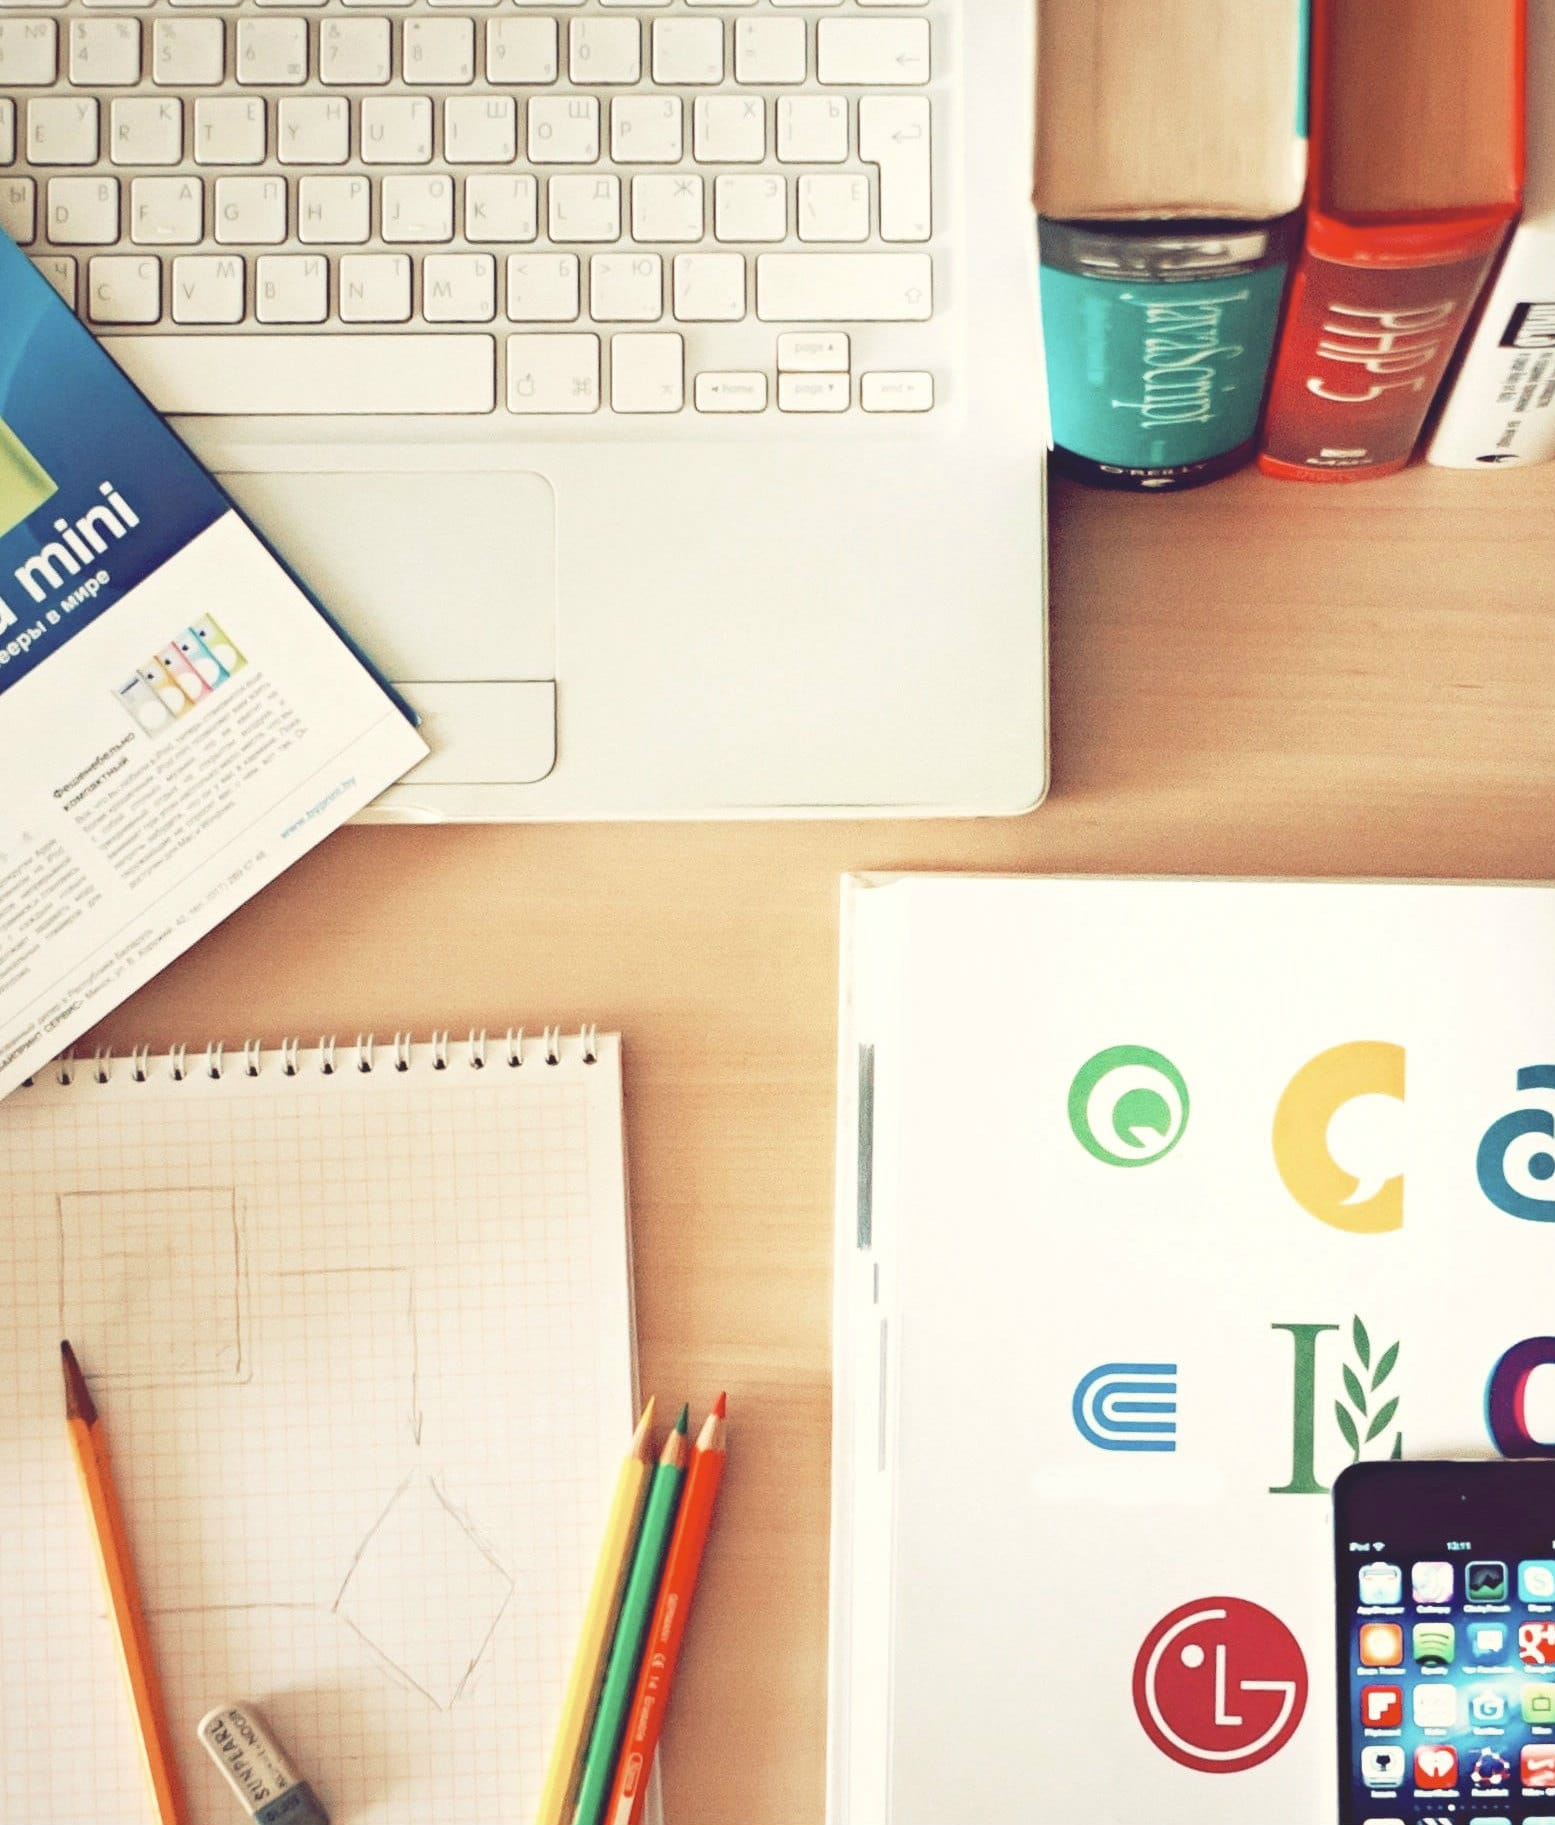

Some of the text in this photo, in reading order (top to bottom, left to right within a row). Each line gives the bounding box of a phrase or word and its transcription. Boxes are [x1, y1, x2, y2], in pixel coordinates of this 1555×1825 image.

[35, 123, 47, 143] E
[119, 124, 131, 142] R
[203, 123, 214, 141] T
[288, 123, 300, 140] Y
[369, 123, 384, 141] U
[537, 121, 553, 140] O
[620, 120, 632, 139] P
[55, 201, 568, 223] D F G H J K L
[98, 281, 453, 301] C V B N M
[1111, 289, 1250, 428] JavaScript
[1314, 301, 1456, 375] PHP
[1306, 374, 1427, 403] 5
[14, 480, 140, 604] mini
[45, 609, 61, 625] в
[60, 570, 111, 613] мире
[1144, 1607, 1297, 1762] LG
